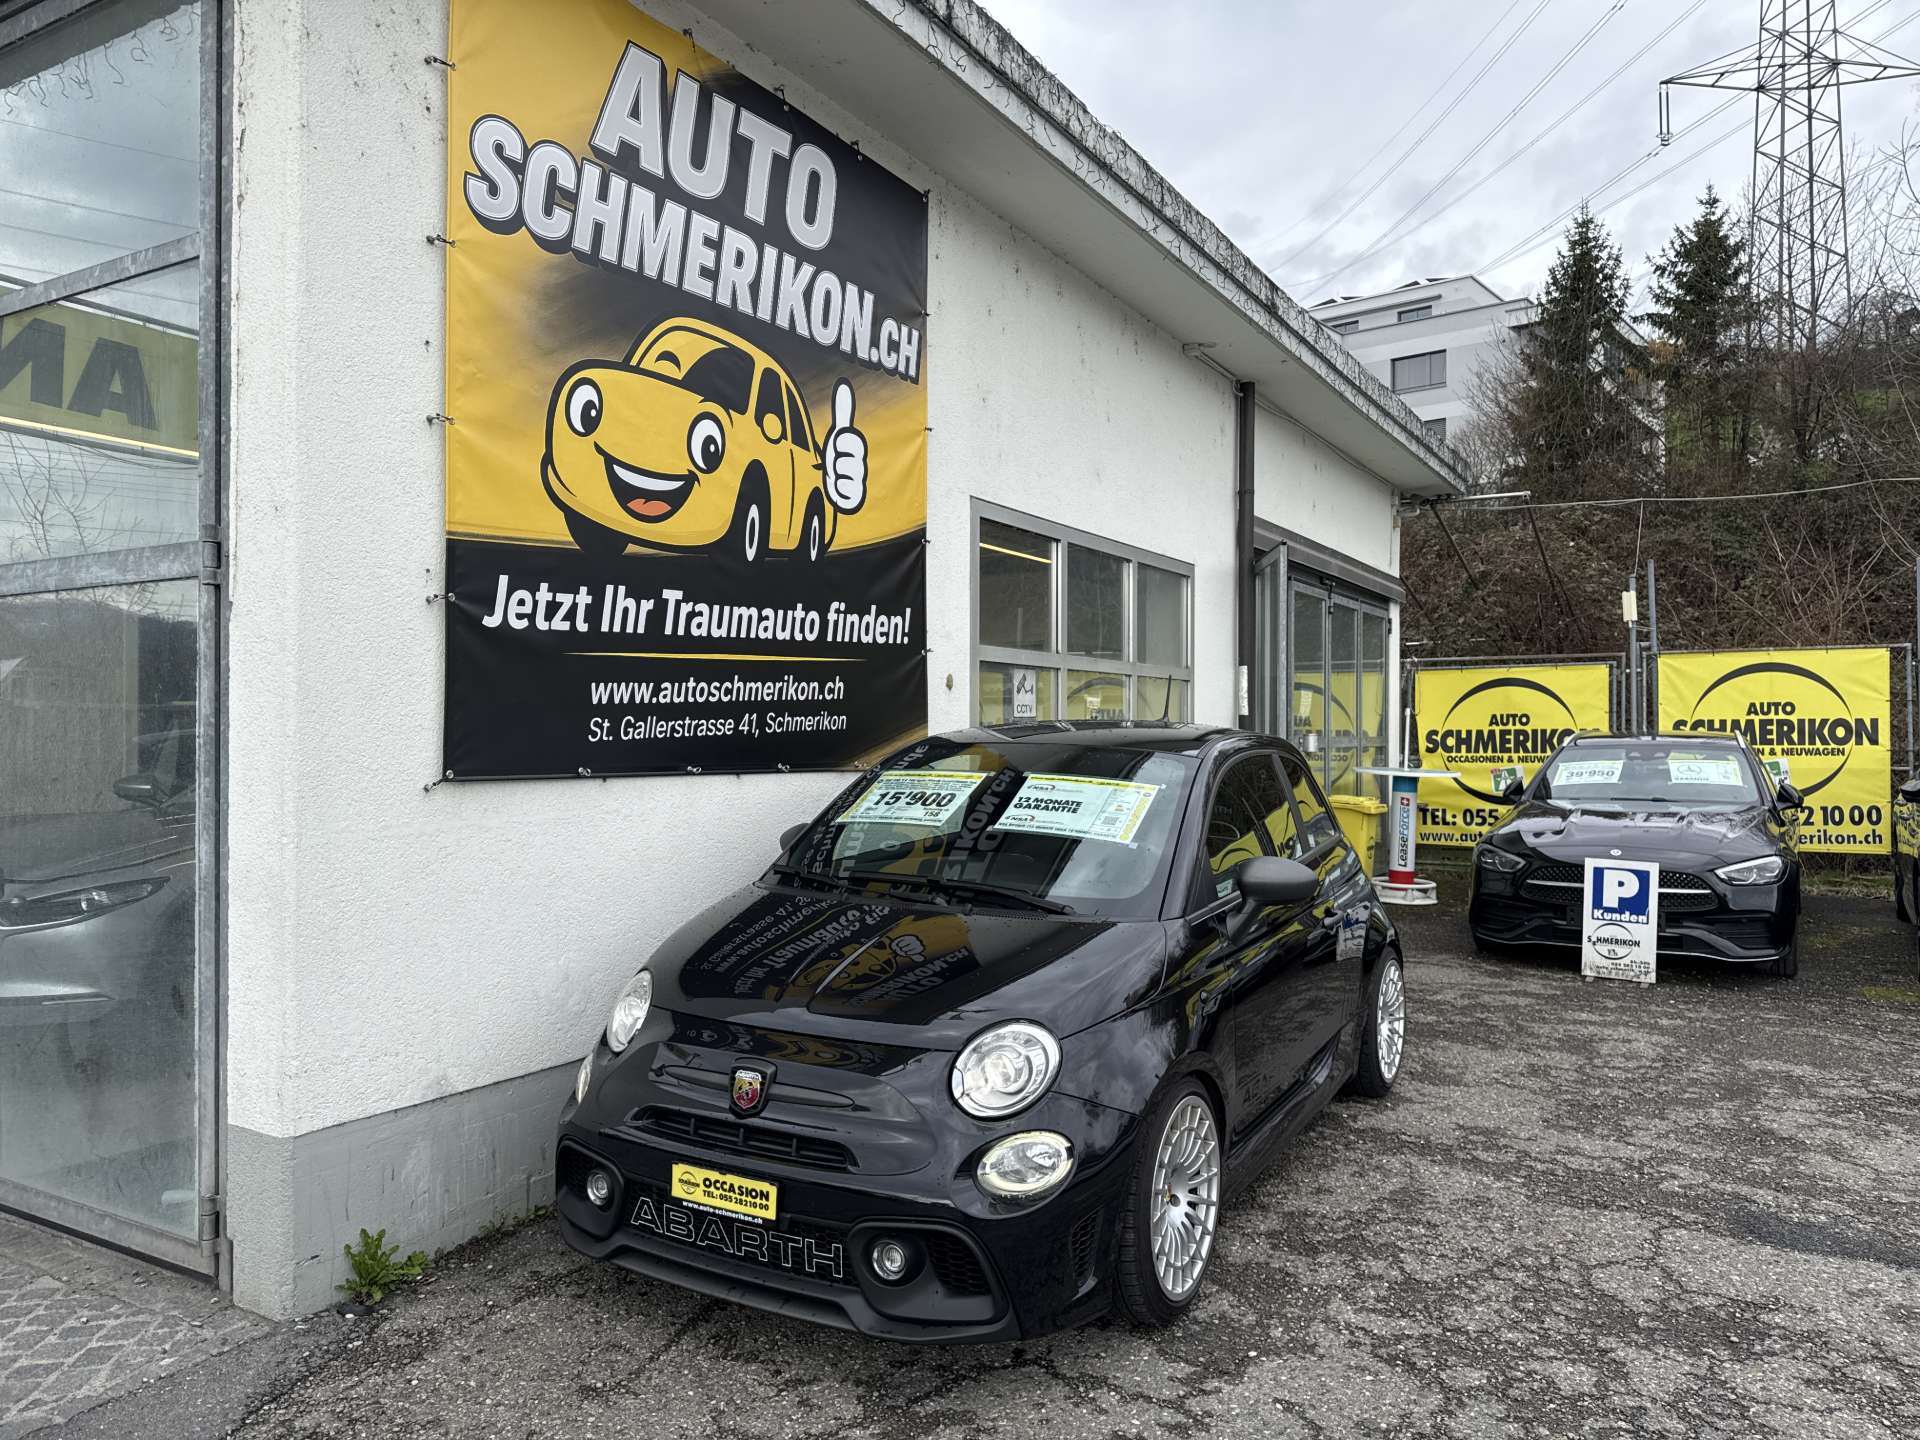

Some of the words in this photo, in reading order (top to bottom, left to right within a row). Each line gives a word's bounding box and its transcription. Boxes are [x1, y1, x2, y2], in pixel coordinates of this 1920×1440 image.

[591, 40, 838, 251] AUTO
[465, 115, 921, 380] SCHMERIKON.CH
[482, 574, 592, 632] Jetzt
[600, 584, 654, 634] Ihr
[662, 588, 820, 641] Traumauto
[827, 601, 912, 644] finden!
[590, 675, 845, 705] www.autoschmerikon.ch
[1016, 703, 1033, 714] CCTV
[1746, 701, 1796, 716] AUTO
[588, 717, 614, 742] St.
[620, 715, 735, 741] Gallerstrasse
[738, 713, 760, 738] 41,
[765, 711, 847, 733] Schmerikon
[1488, 713, 1531, 727] AUTO
[1425, 728, 1577, 755] SCHMERIKO
[1446, 755, 1504, 764] OCCASIONEN
[1506, 755, 1515, 764] &
[1768, 747, 1778, 757] &
[1781, 747, 1846, 757] NEUWAGEN
[873, 790, 957, 808] 15'900
[1013, 802, 1081, 814] GARANTIE
[1017, 796, 1033, 804] 12
[1032, 796, 1084, 808] MONATE
[1418, 807, 1457, 826] TEL:
[1820, 805, 1845, 826] 10
[1849, 805, 1883, 826] 00
[1398, 807, 1410, 867] LeaseForce
[1420, 830, 1485, 843] www.aut
[1799, 829, 1883, 845] erikon.ch
[1602, 868, 1640, 908] P
[1593, 908, 1649, 923] Kunden
[702, 1177, 770, 1202] OCCASION
[703, 1190, 718, 1200] TEL:
[630, 1196, 843, 1278] ABARTH
